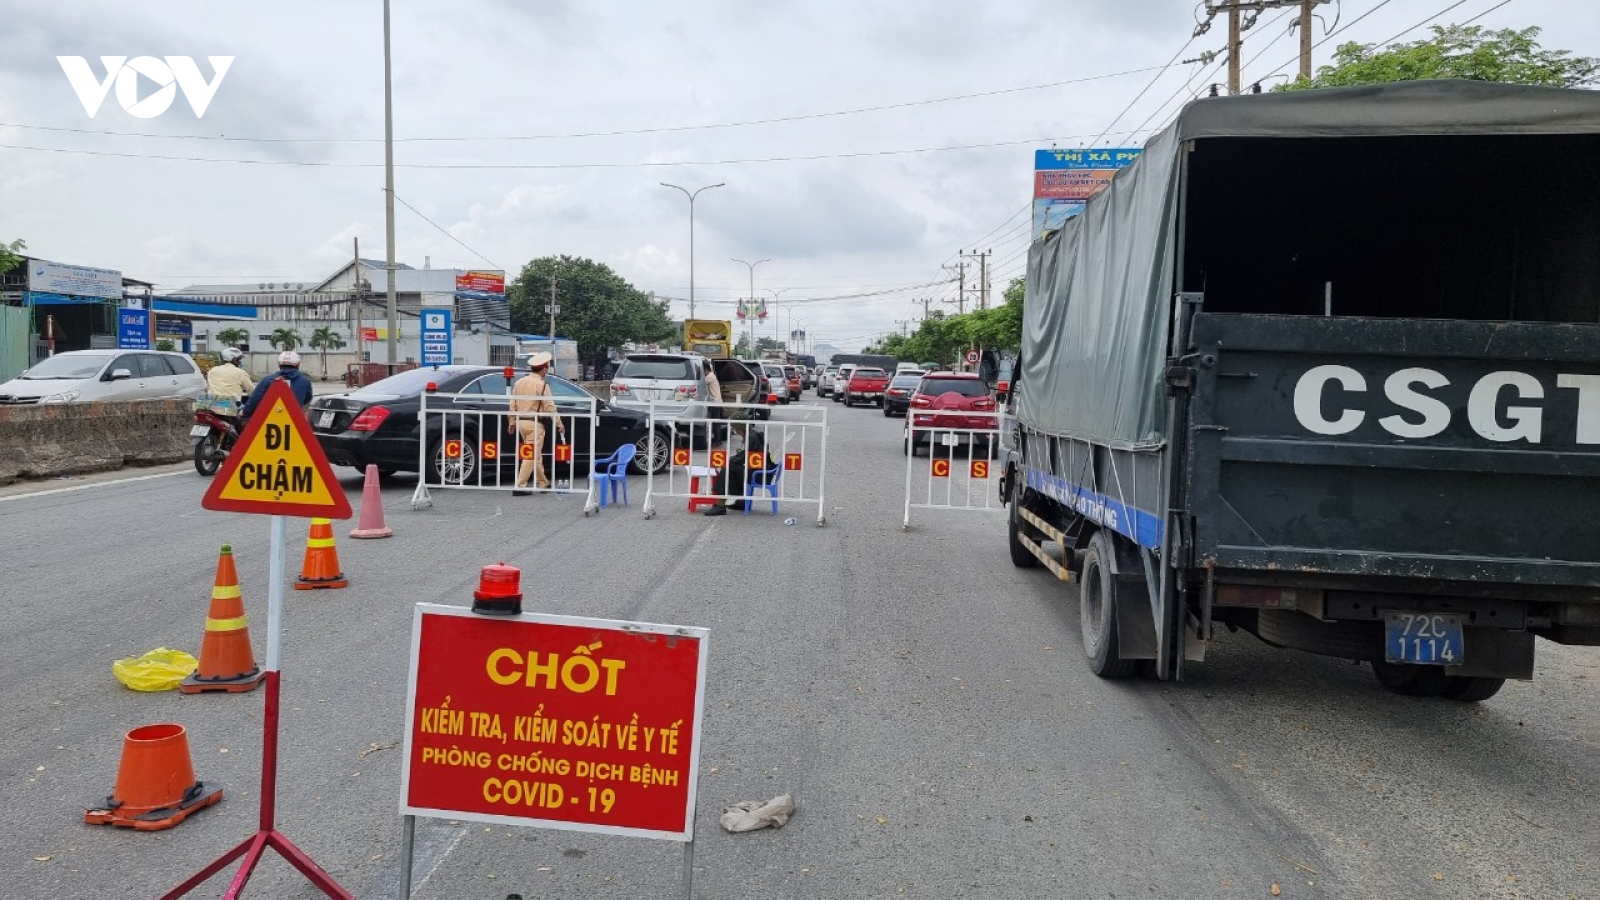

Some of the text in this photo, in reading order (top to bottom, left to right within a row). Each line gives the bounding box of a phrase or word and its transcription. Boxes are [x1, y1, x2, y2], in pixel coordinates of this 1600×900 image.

[1293, 364, 1600, 445] CSGT
[265, 423, 291, 451] ĐI
[239, 458, 313, 497] CHẬM
[1400, 614, 1446, 638] 72C
[486, 640, 626, 696] CHỐT
[1398, 637, 1454, 662] 1114
[420, 695, 684, 755] KIỂM TRA, KIỂM SOÁT VỀ Y TẾ
[422, 744, 679, 789] PHÒNG CHỐNG DỊCH BỆNH
[482, 777, 565, 809] COVID
[588, 787, 616, 814] 19
